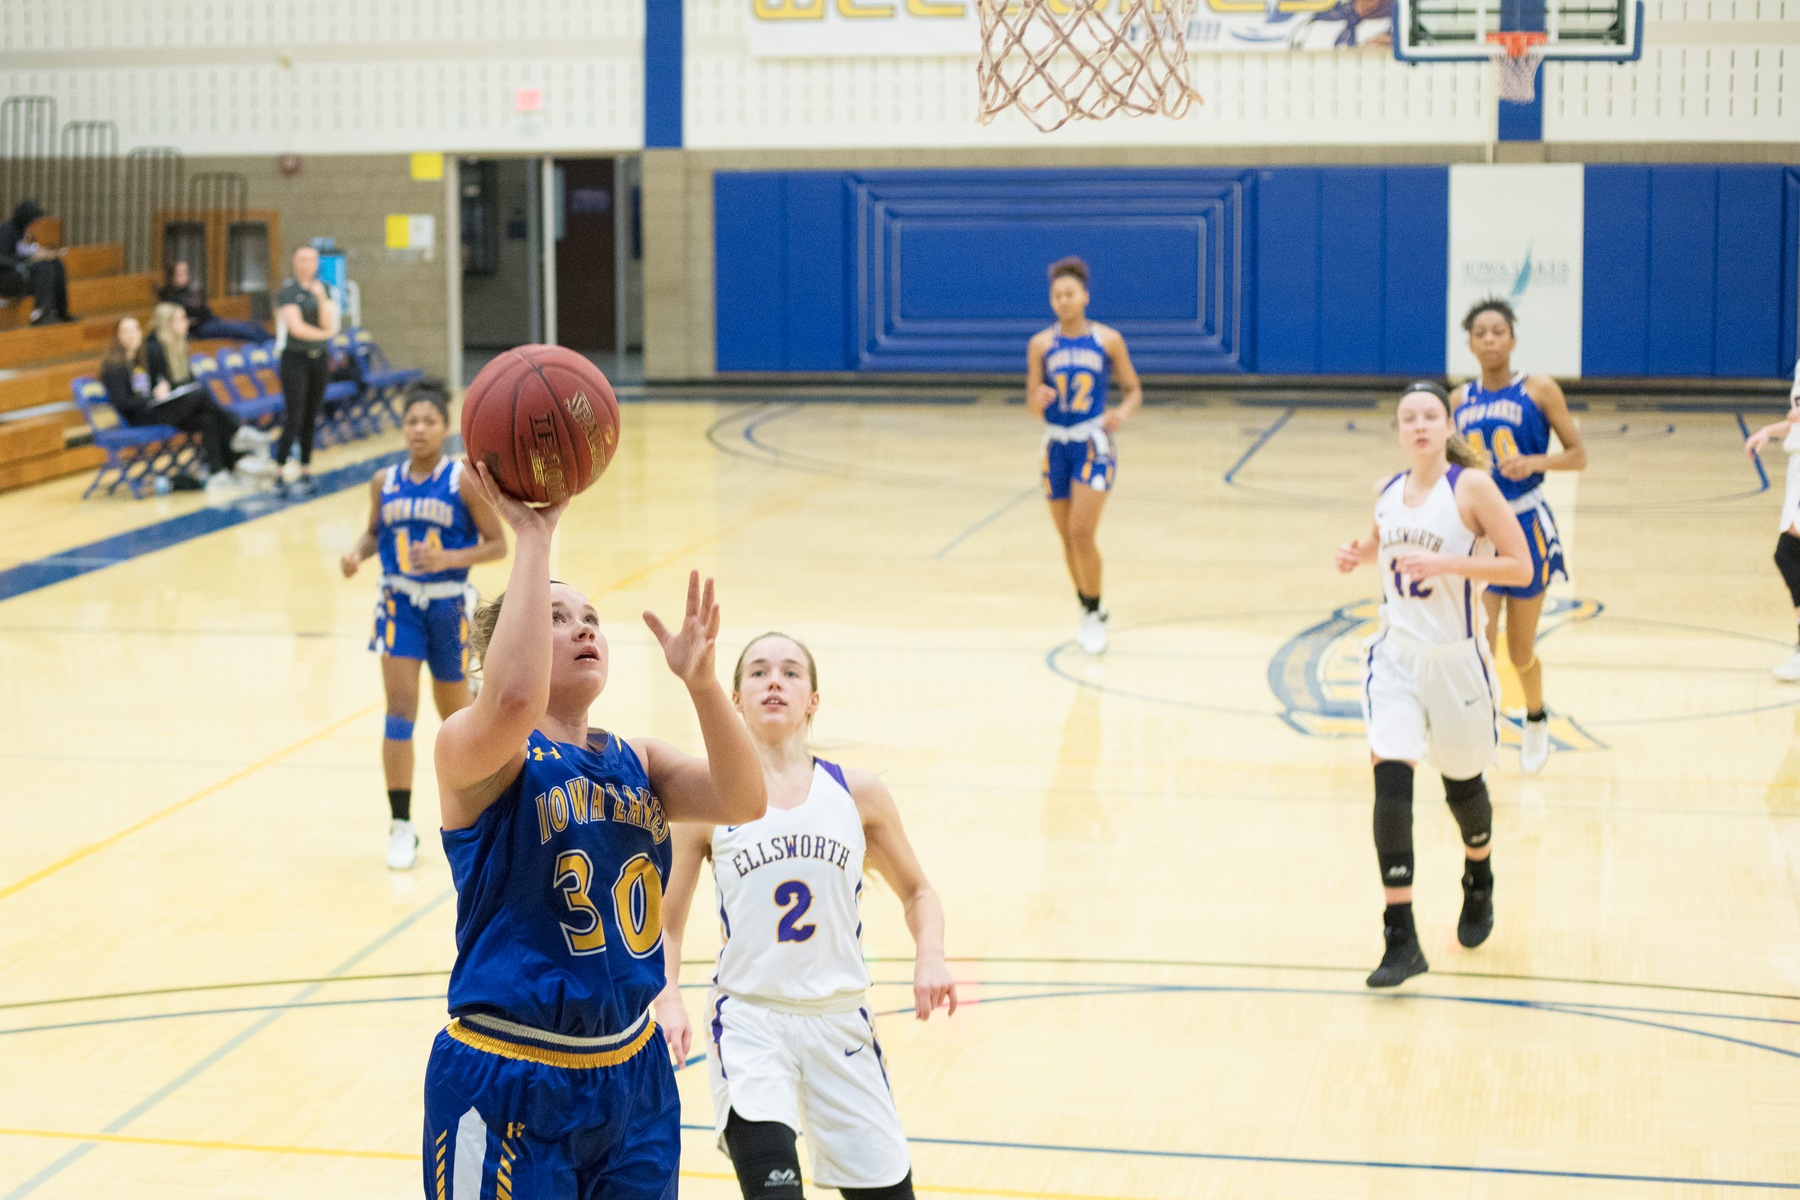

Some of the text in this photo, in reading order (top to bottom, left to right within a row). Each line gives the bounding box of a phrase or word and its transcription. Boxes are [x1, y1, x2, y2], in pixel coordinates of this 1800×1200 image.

[1054, 371, 1096, 414] 12
[535, 775, 605, 845] IOWA
[732, 834, 851, 878] ELLSWORTH
[553, 848, 664, 960] 30
[772, 877, 818, 945] 2
